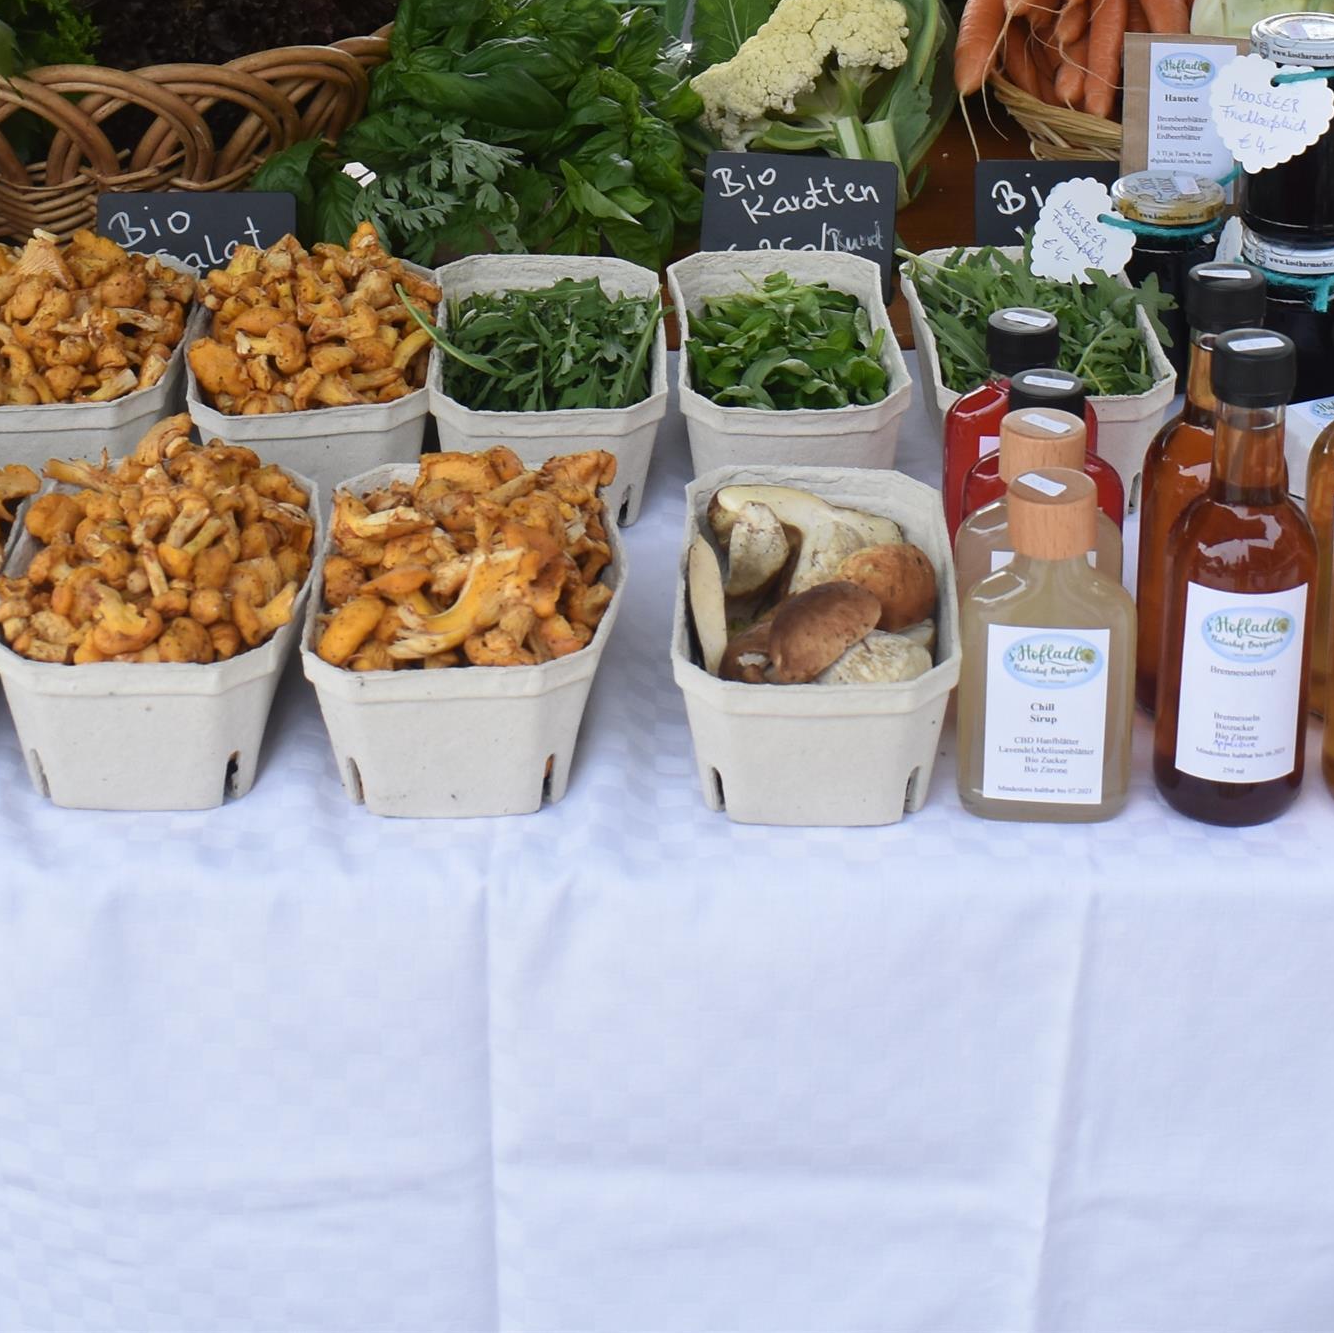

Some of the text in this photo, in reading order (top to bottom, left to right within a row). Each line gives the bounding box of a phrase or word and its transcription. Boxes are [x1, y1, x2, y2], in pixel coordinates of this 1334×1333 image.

[1165, 94, 1199, 102] Haustee
[712, 165, 776, 197] Bio
[742, 176, 879, 224] Karotten
[992, 173, 1045, 215] Bi
[108, 206, 191, 248] Bio
[1030, 702, 1055, 712] Chill
[1030, 714, 1057, 724] Sirup
[1014, 736, 1034, 745] CBD
